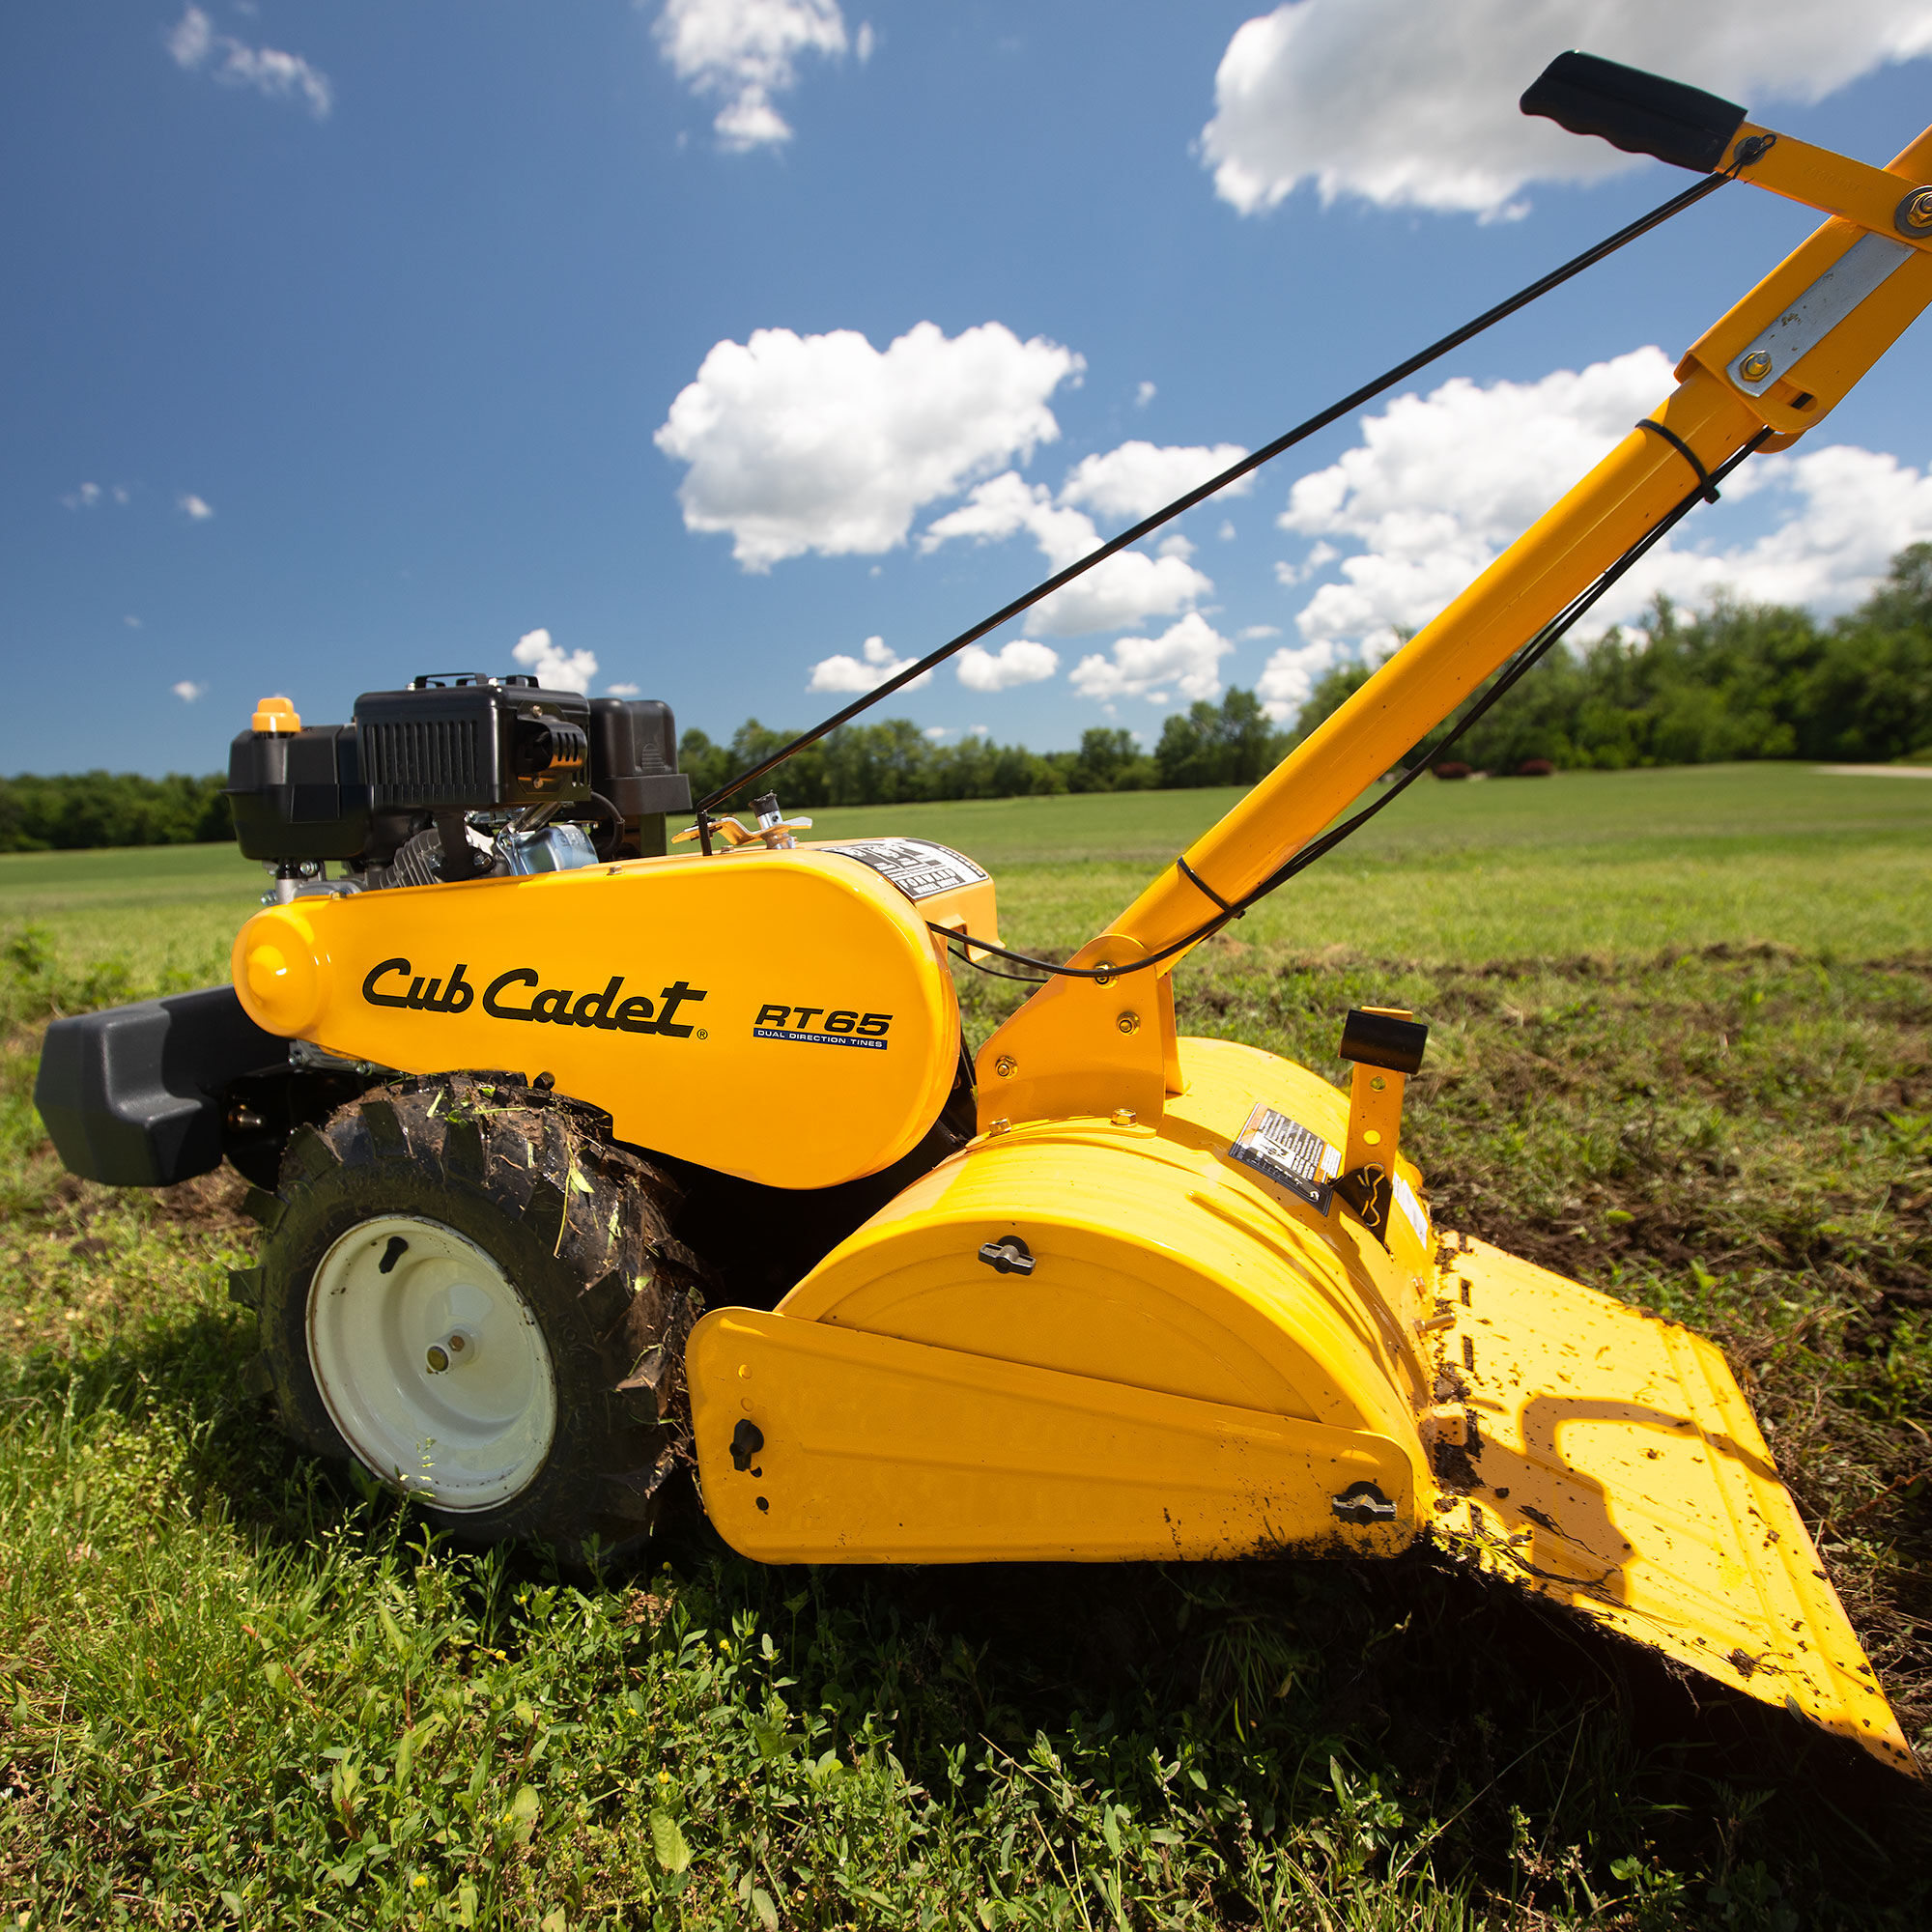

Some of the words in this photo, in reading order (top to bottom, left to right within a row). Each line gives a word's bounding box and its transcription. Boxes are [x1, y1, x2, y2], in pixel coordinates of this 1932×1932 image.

[898, 868, 958, 890] FORWARD
[362, 958, 474, 1013] Cub
[483, 968, 708, 1038] Cadet
[757, 1030, 785, 1038] DUAL
[788, 1033, 846, 1044] DIRECTION
[850, 1038, 883, 1048] TINES
